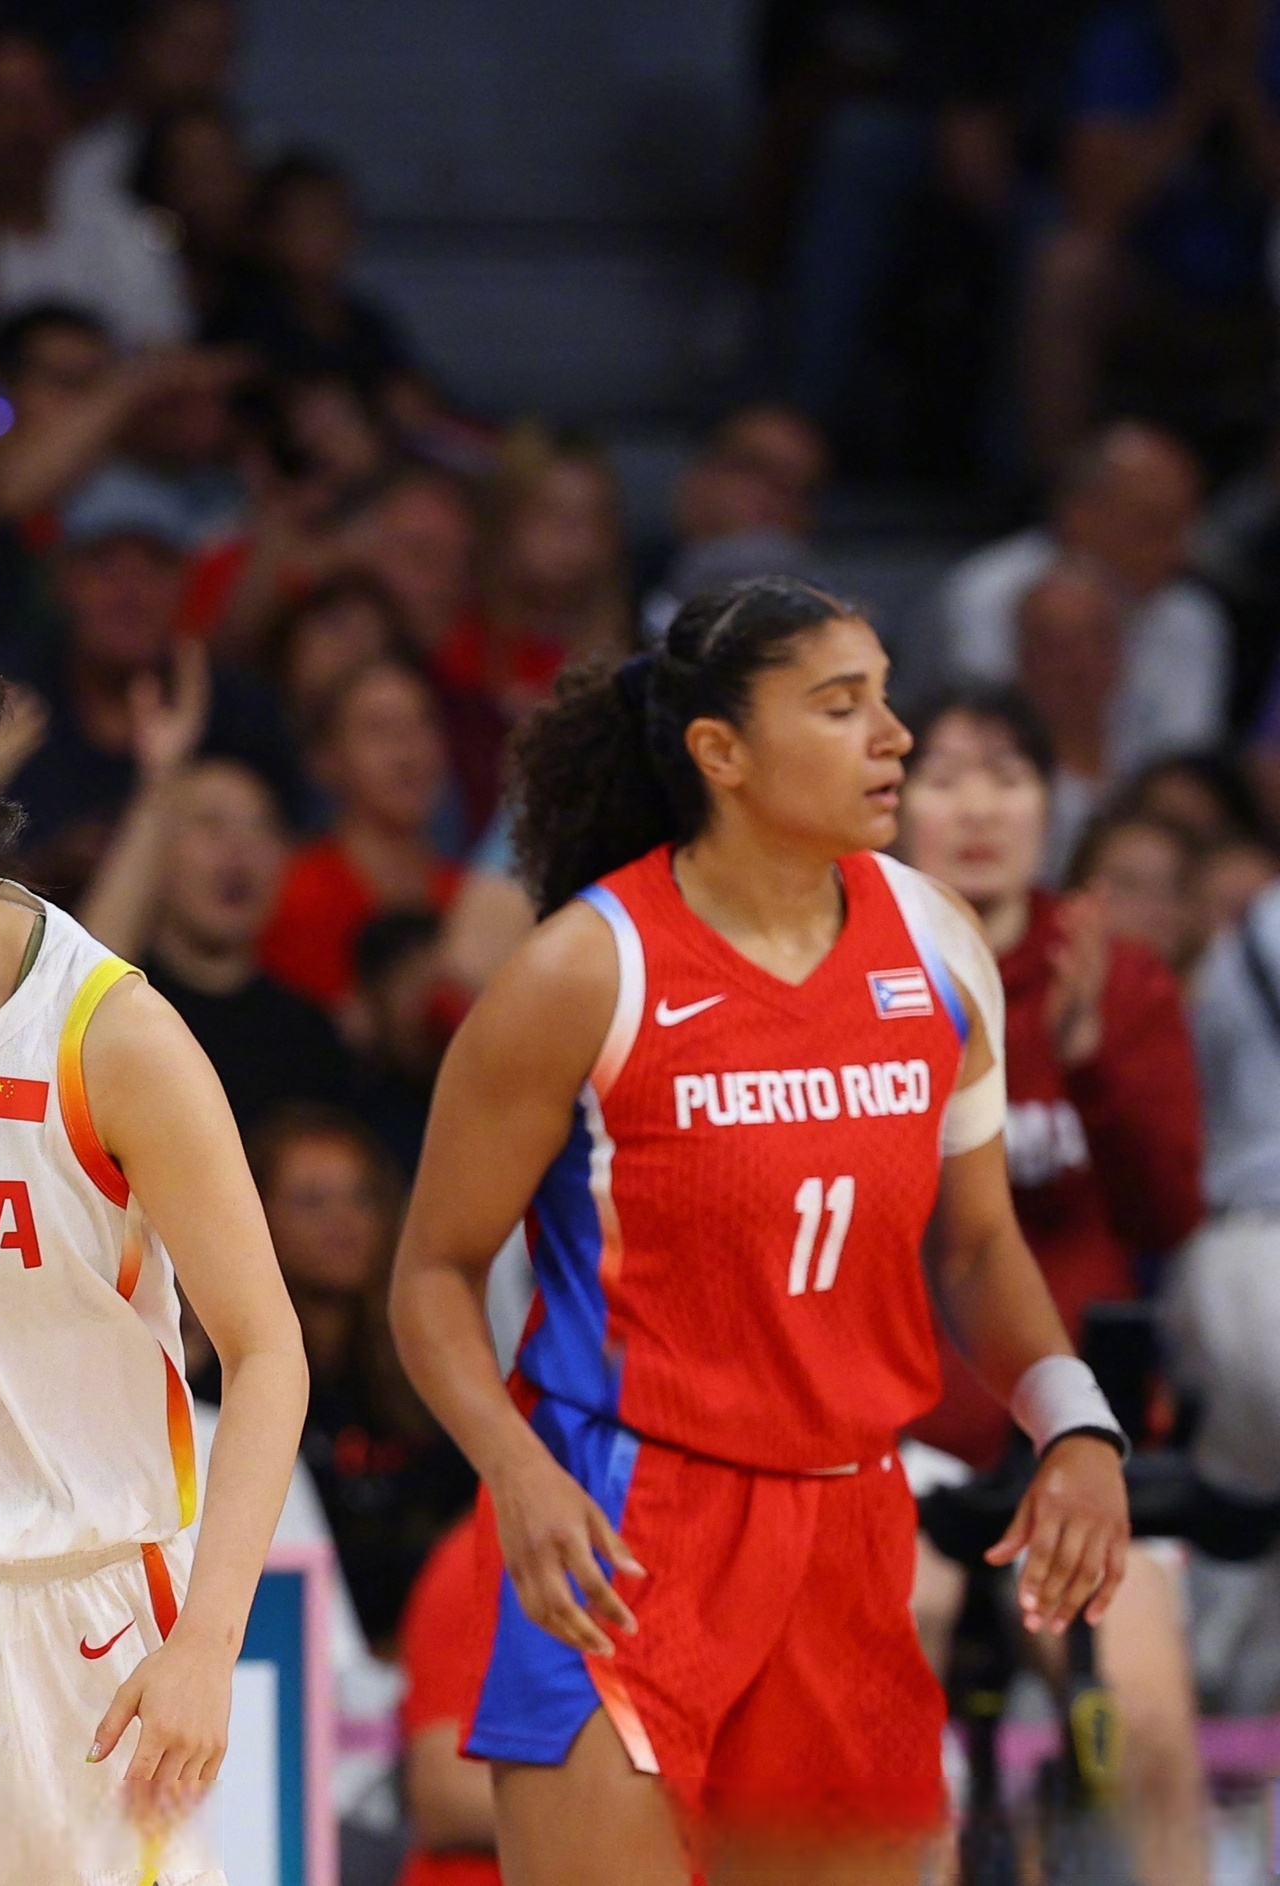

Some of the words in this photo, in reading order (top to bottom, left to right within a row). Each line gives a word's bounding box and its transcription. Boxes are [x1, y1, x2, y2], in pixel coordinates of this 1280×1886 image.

[674, 1067, 841, 1130] PUERTO
[841, 1059, 930, 1118] RICO
[788, 1175, 855, 1297] 11
